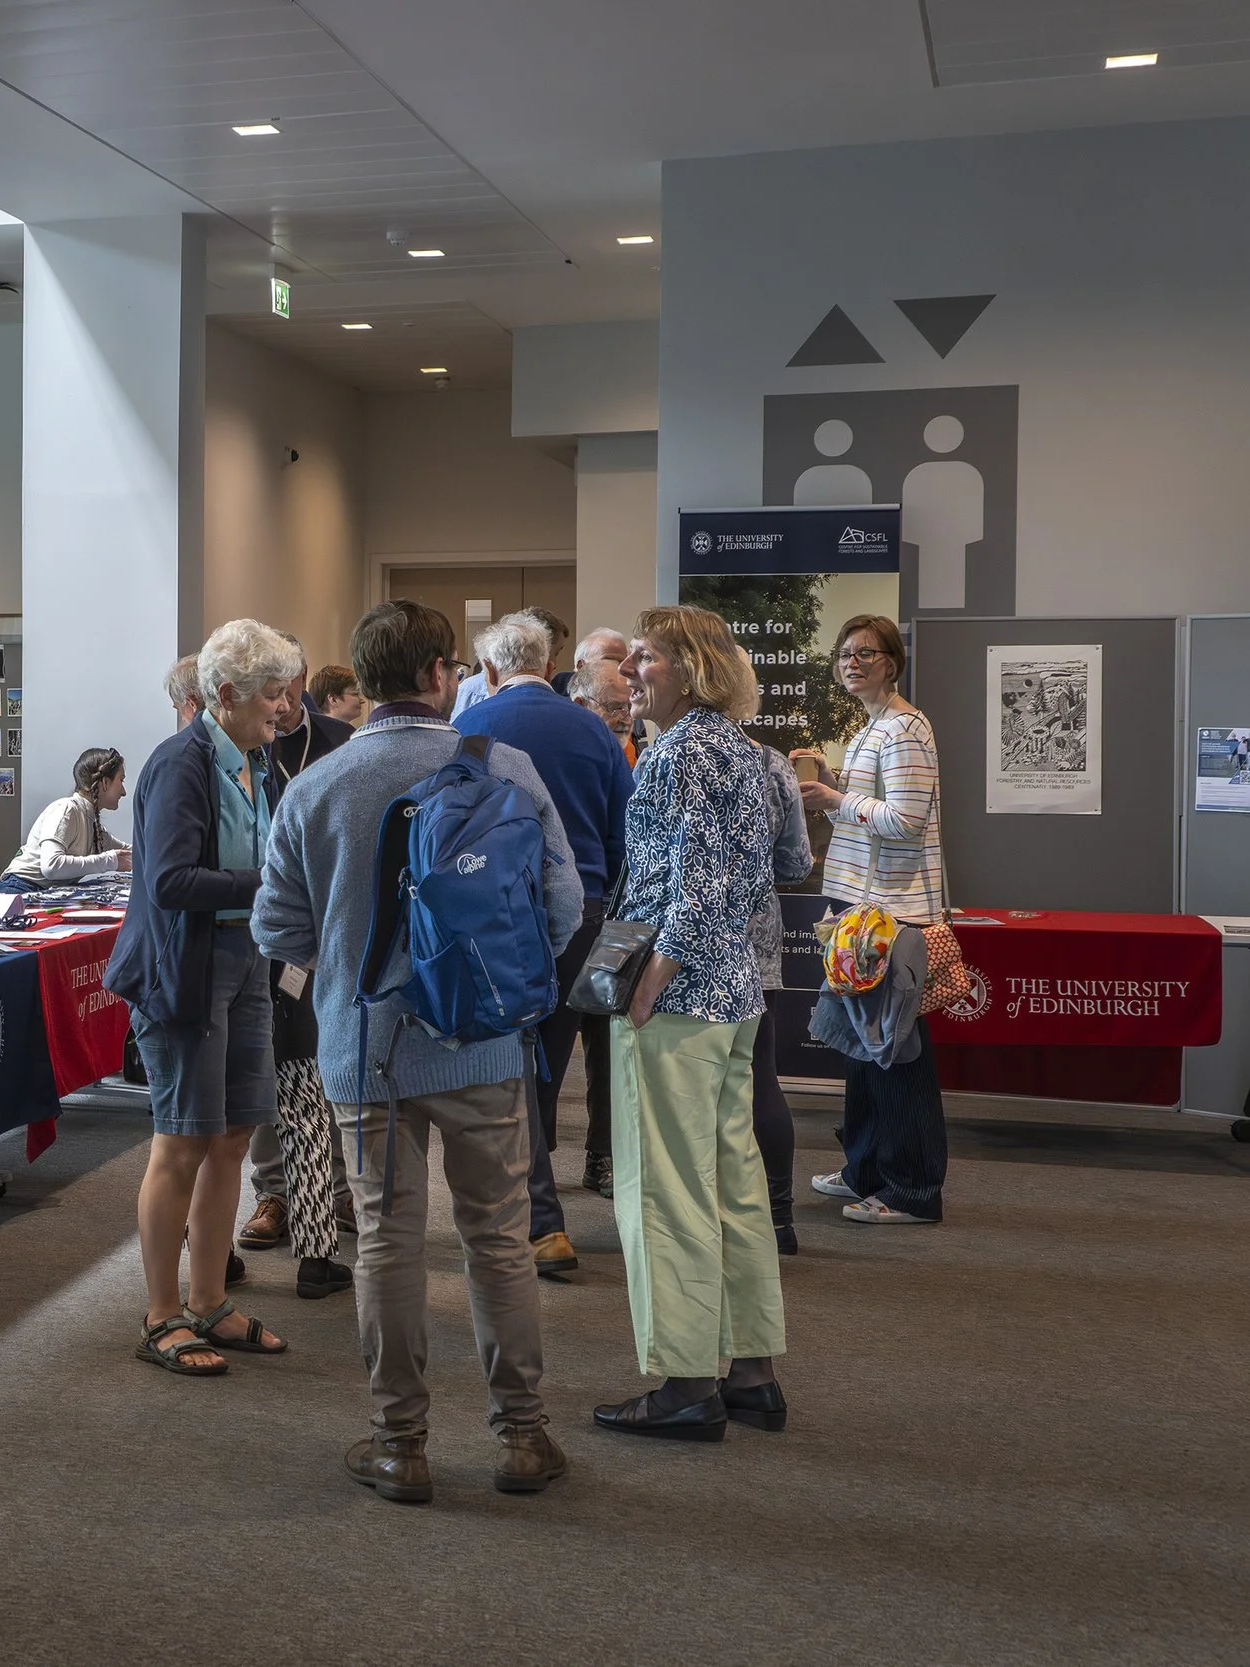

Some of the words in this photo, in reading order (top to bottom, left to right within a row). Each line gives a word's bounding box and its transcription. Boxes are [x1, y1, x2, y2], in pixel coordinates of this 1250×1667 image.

[717, 534, 734, 542] THE
[735, 534, 784, 542] UNIVERSITY
[865, 533, 888, 542] CSFL
[717, 542, 724, 552] of
[725, 542, 773, 550] EDINBURGH
[765, 619, 792, 634] for
[748, 649, 807, 665] inable
[771, 681, 806, 696] and
[783, 930, 796, 939] nd
[792, 946, 811, 954] and
[71, 965, 88, 989] THE
[1006, 977, 1051, 995] THE
[1056, 979, 1190, 998] UNIVERSITY
[78, 995, 88, 1022] of
[89, 989, 122, 1014] EDINB
[1006, 996, 1026, 1019] of
[1028, 998, 1160, 1017] EDINBURGH
